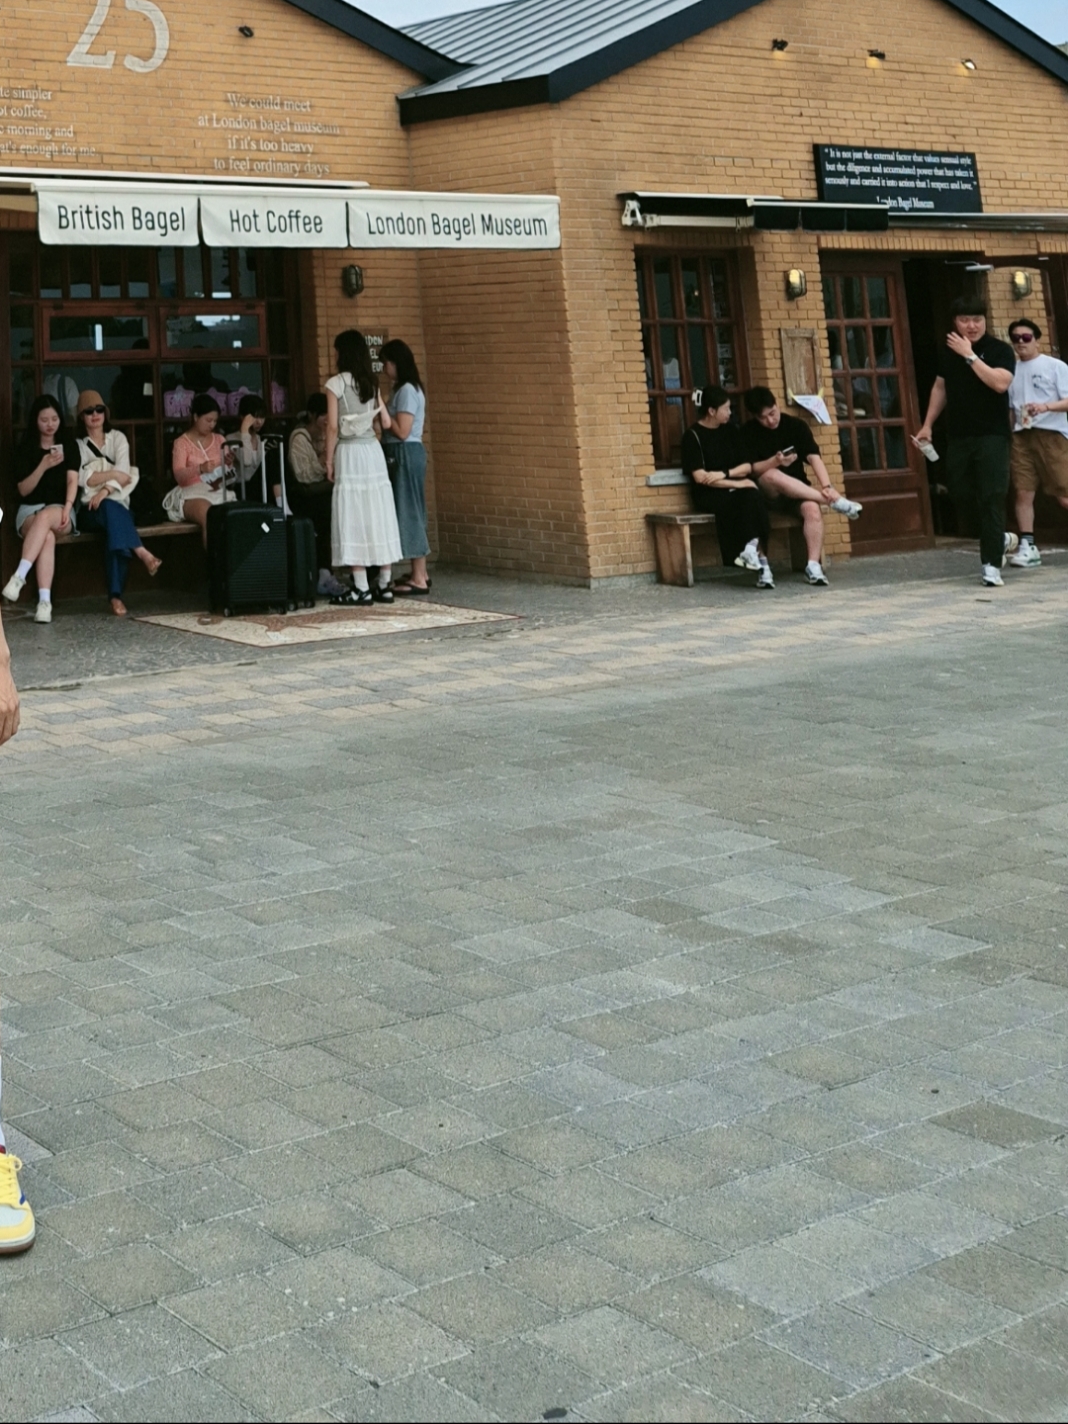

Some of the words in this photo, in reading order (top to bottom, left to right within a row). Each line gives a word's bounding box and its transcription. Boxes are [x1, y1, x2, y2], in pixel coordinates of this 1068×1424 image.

[12, 87, 52, 102] simpler
[227, 93, 246, 107] We
[249, 95, 280, 110] could
[283, 99, 311, 112] meet
[10, 105, 47, 119] coffee,
[7, 125, 51, 139] morning
[54, 125, 74, 138] and
[198, 115, 209, 126] at
[212, 113, 257, 128] London
[259, 116, 290, 134] bagel
[293, 121, 340, 134] museum
[20, 143, 58, 158] enough
[61, 143, 77, 155] for
[80, 146, 99, 157] me.
[227, 135, 239, 149] if
[240, 136, 256, 150] it's
[259, 137, 278, 151] too
[281, 138, 314, 156] heavy
[214, 158, 225, 170] to
[229, 156, 250, 171] feel
[253, 158, 302, 176] ordinary
[304, 160, 330, 177] days
[57, 205, 124, 230] British
[132, 207, 185, 237] Bagel
[229, 209, 261, 233] Hot
[266, 210, 323, 233] Coffee
[366, 212, 426, 235] London
[431, 213, 476, 241] Bagel
[481, 214, 547, 236] Museum
[365, 335, 383, 346] DON
